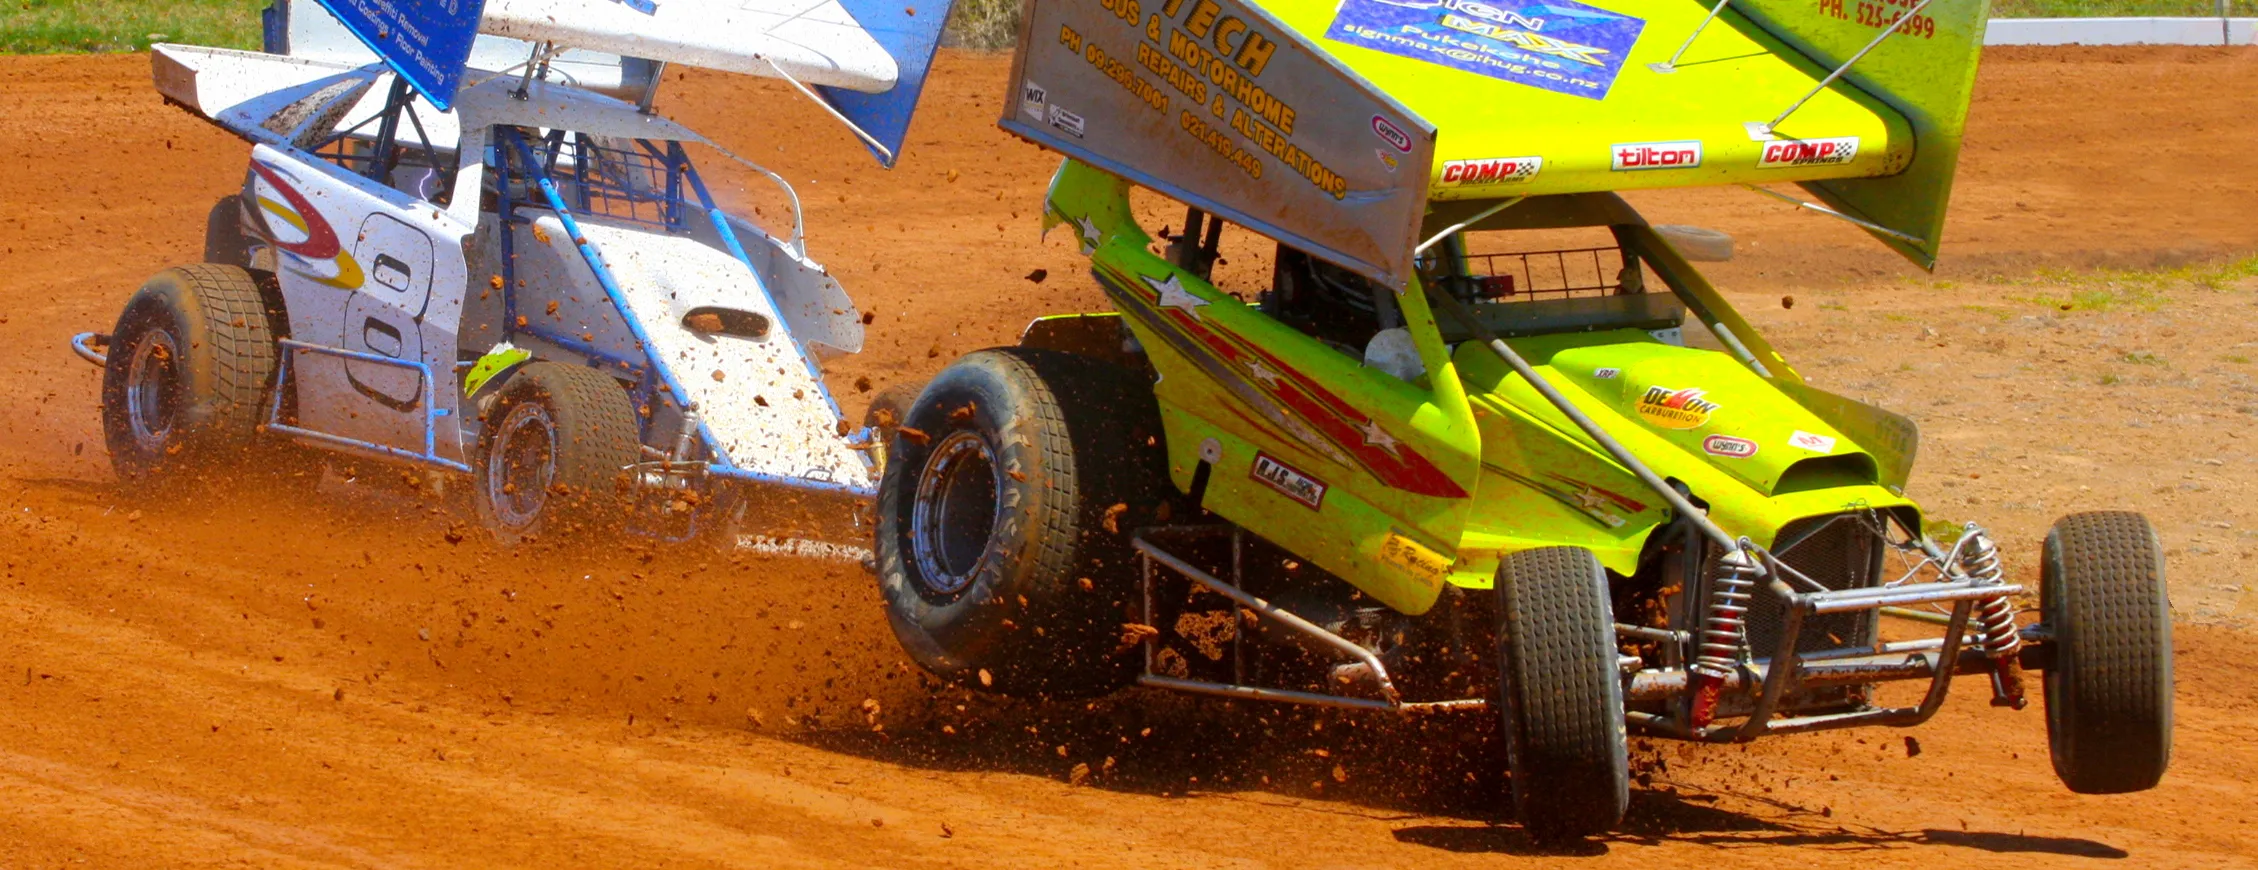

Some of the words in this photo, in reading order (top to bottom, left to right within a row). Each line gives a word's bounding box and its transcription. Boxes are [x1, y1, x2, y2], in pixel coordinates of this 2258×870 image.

[358, 0, 389, 34] Coatings
[395, 32, 414, 56] Floor
[415, 49, 445, 86] Painting
[398, 12, 429, 47] Removal
[1400, 25, 1562, 69] Pukekohe
[1442, 14, 1611, 67] MAX
[1060, 23, 1082, 55] PH
[1085, 43, 1169, 116] 09.296.7001
[1146, 12, 1161, 45] &
[1168, 27, 1296, 137] MOTORHOME
[1343, 24, 1600, 89] signmax@ihug.co.nz
[1025, 88, 1045, 104] WIX
[1137, 40, 1207, 106] REPAIRS
[1211, 94, 1225, 121] &
[1229, 107, 1347, 200] ALTERATIONS
[1618, 147, 1695, 167] tilton
[1764, 142, 1835, 163] COMP
[1443, 162, 1517, 183] COMP
[1639, 404, 1703, 423] CARBURETION
[1643, 386, 1718, 415] DEMON
